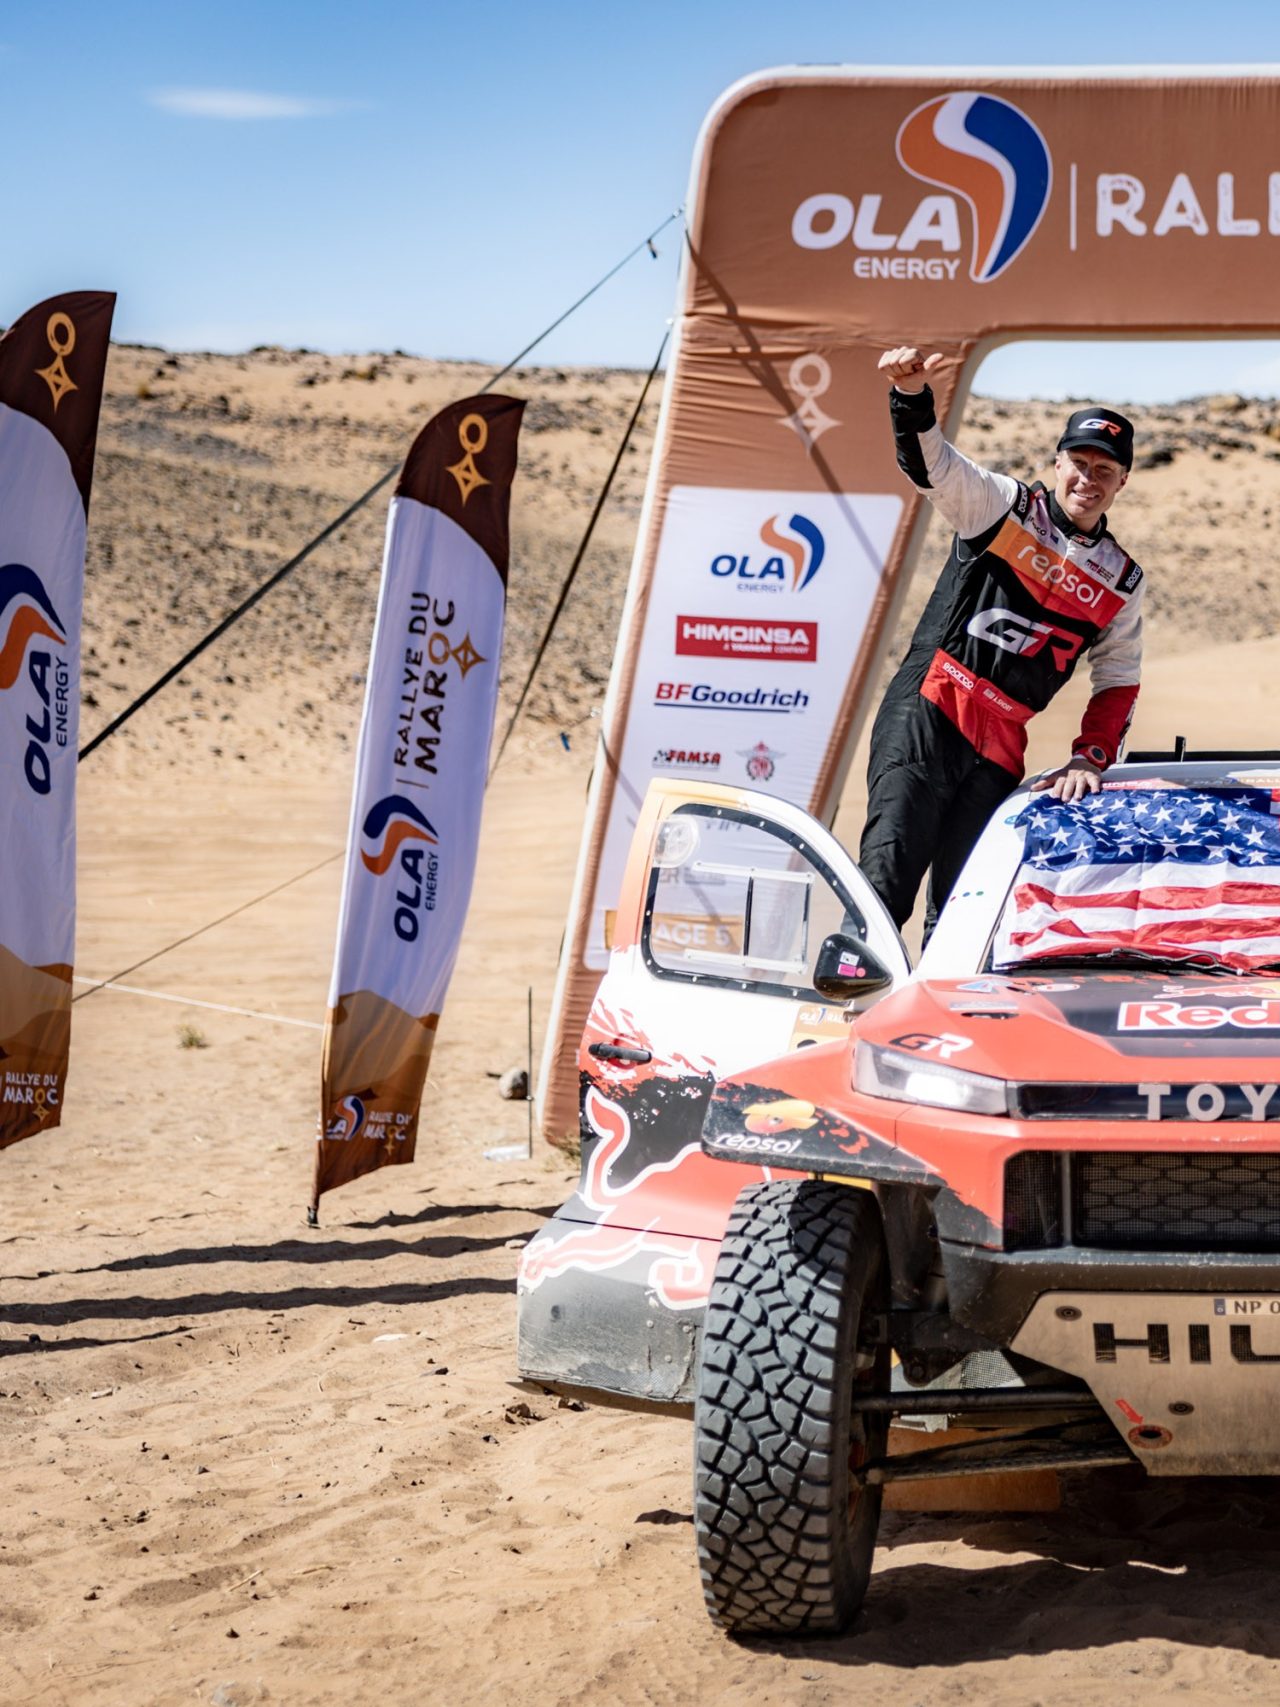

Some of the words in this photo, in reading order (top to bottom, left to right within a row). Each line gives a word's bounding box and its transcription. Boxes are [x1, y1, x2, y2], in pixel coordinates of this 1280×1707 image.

[791, 193, 962, 252] OLA
[854, 257, 961, 281] ENERGY
[1078, 418, 1122, 437] GR
[711, 555, 785, 580] OLA
[1017, 545, 1105, 609] repsol
[736, 583, 784, 593] ENERGY
[408, 590, 432, 637] DU
[682, 622, 810, 646] HIMOINSA
[966, 606, 1085, 673] GR
[414, 598, 456, 776] MAROC
[943, 662, 975, 691] sparco
[55, 656, 69, 748] ENERGY
[393, 647, 424, 766] RALLYE
[655, 682, 809, 708] BFGoodrich
[24, 649, 52, 796] OLA
[424, 851, 440, 912] ENERGY
[393, 849, 424, 943] OLA
[653, 922, 707, 945] AGE
[715, 925, 731, 947] 5
[889, 1032, 974, 1060] GR
[6, 1071, 41, 1087] RALLYE
[43, 1074, 58, 1087] DU
[3, 1086, 59, 1105] MAROC
[715, 1132, 803, 1154] repsol
[1233, 1300, 1262, 1315] NP
